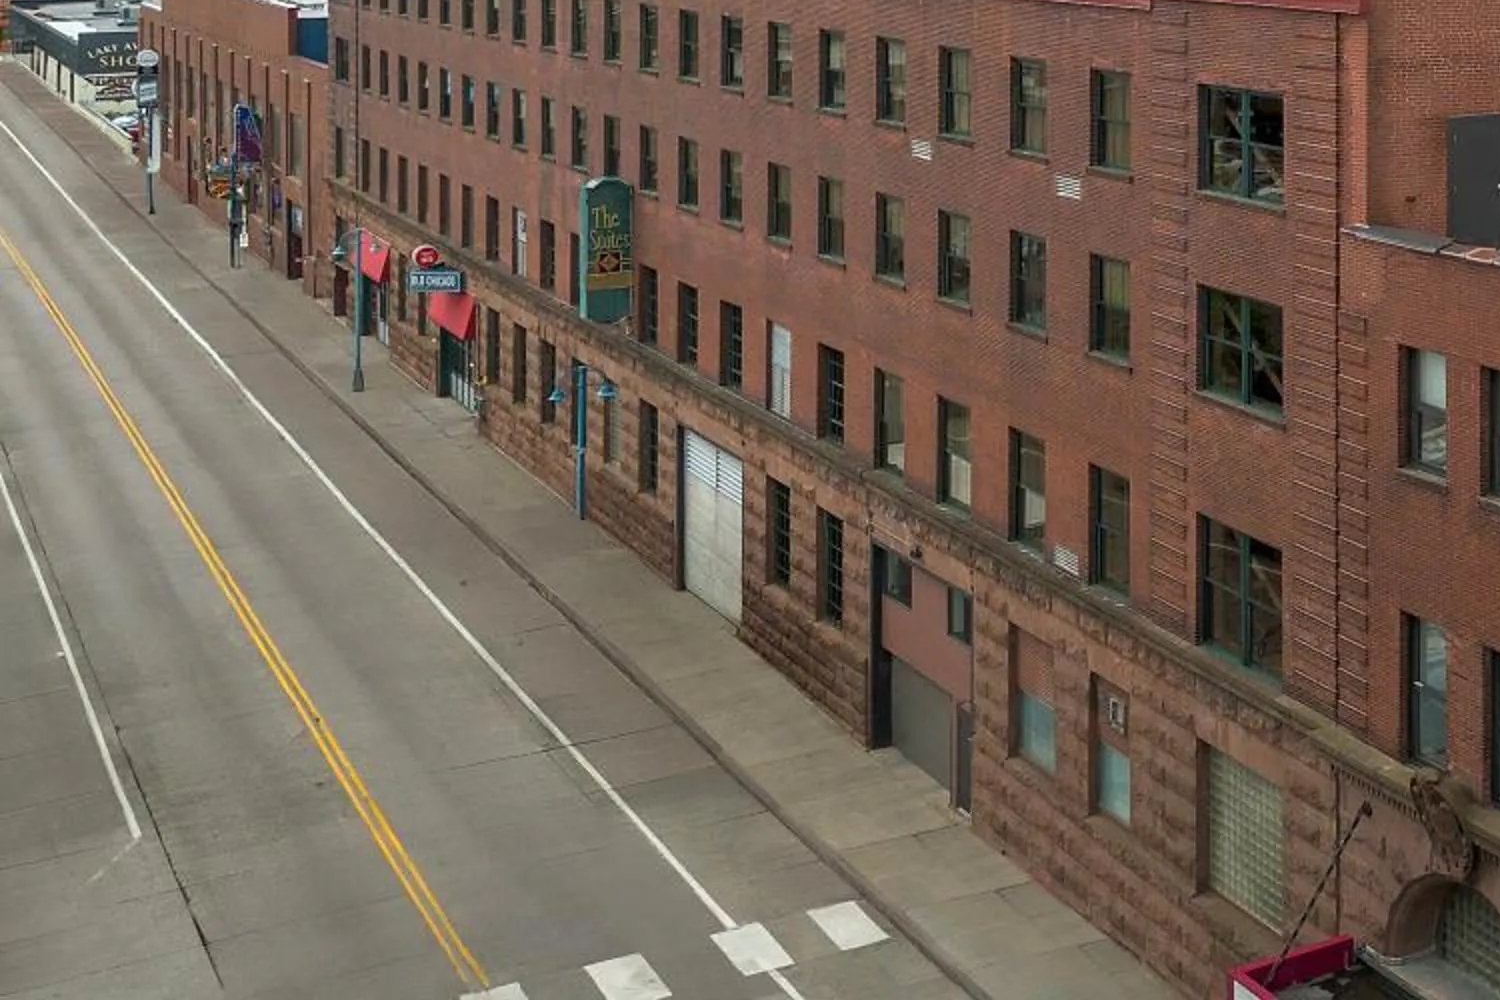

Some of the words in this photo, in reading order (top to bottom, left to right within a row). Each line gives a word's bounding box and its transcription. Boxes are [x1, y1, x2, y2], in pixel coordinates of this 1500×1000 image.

[100, 55, 138, 68] SHO
[591, 204, 620, 229] The
[590, 229, 632, 251] Suites
